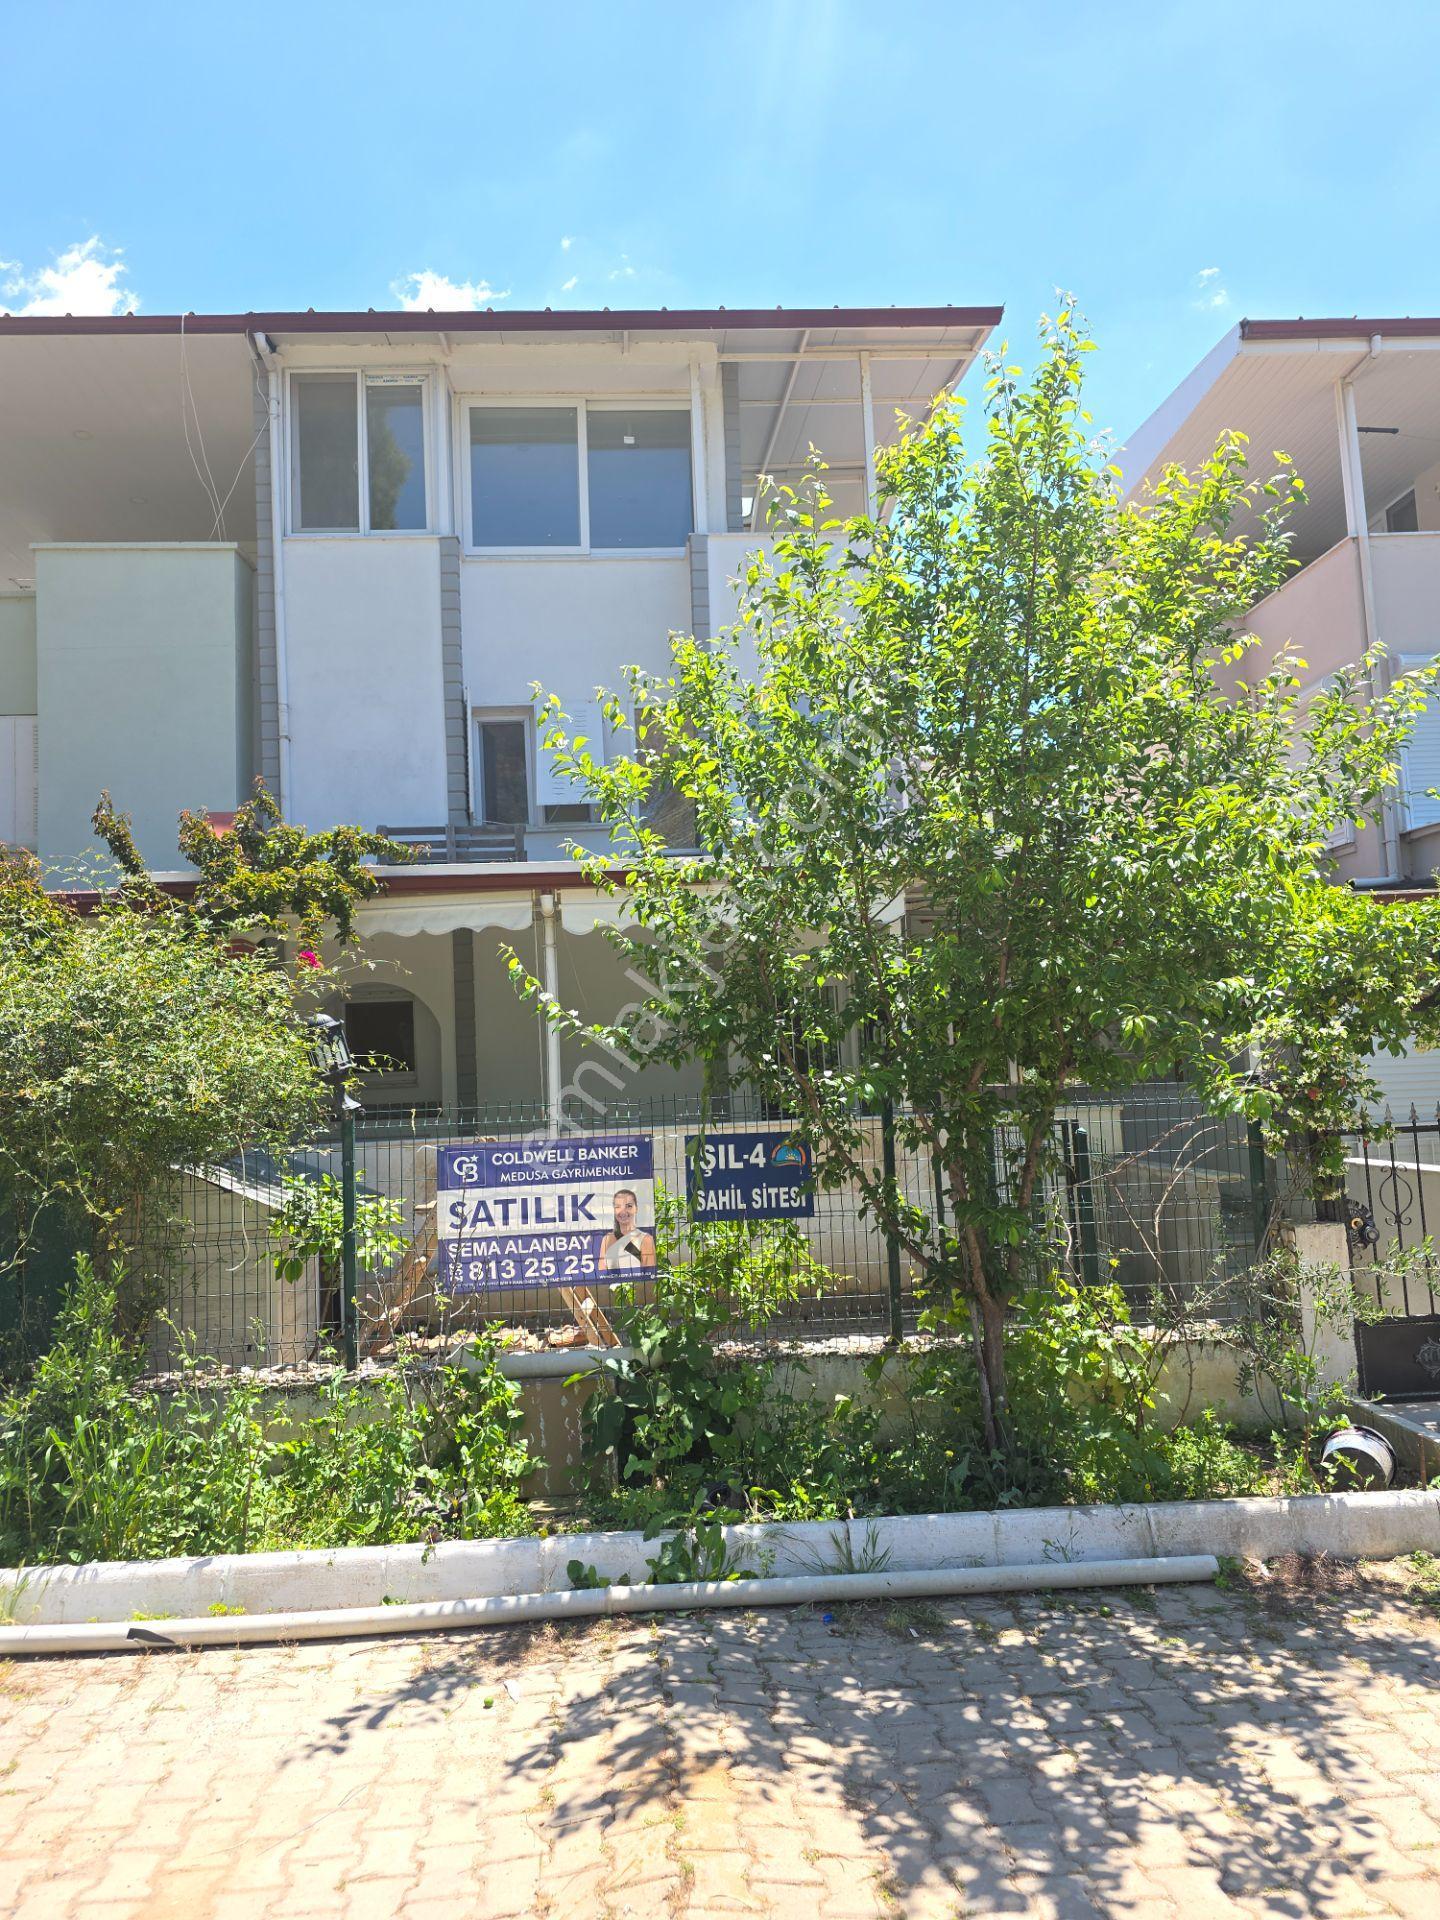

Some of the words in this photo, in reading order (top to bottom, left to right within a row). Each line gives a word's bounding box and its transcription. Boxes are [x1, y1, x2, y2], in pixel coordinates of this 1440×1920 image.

[491, 1149, 574, 1166] COLDWELL
[578, 1145, 638, 1161] BANKER
[500, 1170, 549, 1182] MEDUSA
[551, 1165, 634, 1179] GAYRİMENKUL
[696, 1183, 747, 1211] SAHİL
[449, 1193, 597, 1229] SATILIK
[448, 1241, 502, 1260] SEMA
[504, 1235, 591, 1255] ALANBAY
[469, 1259, 516, 1281] 813
[524, 1256, 556, 1278] 25
[564, 1254, 595, 1275] 25
